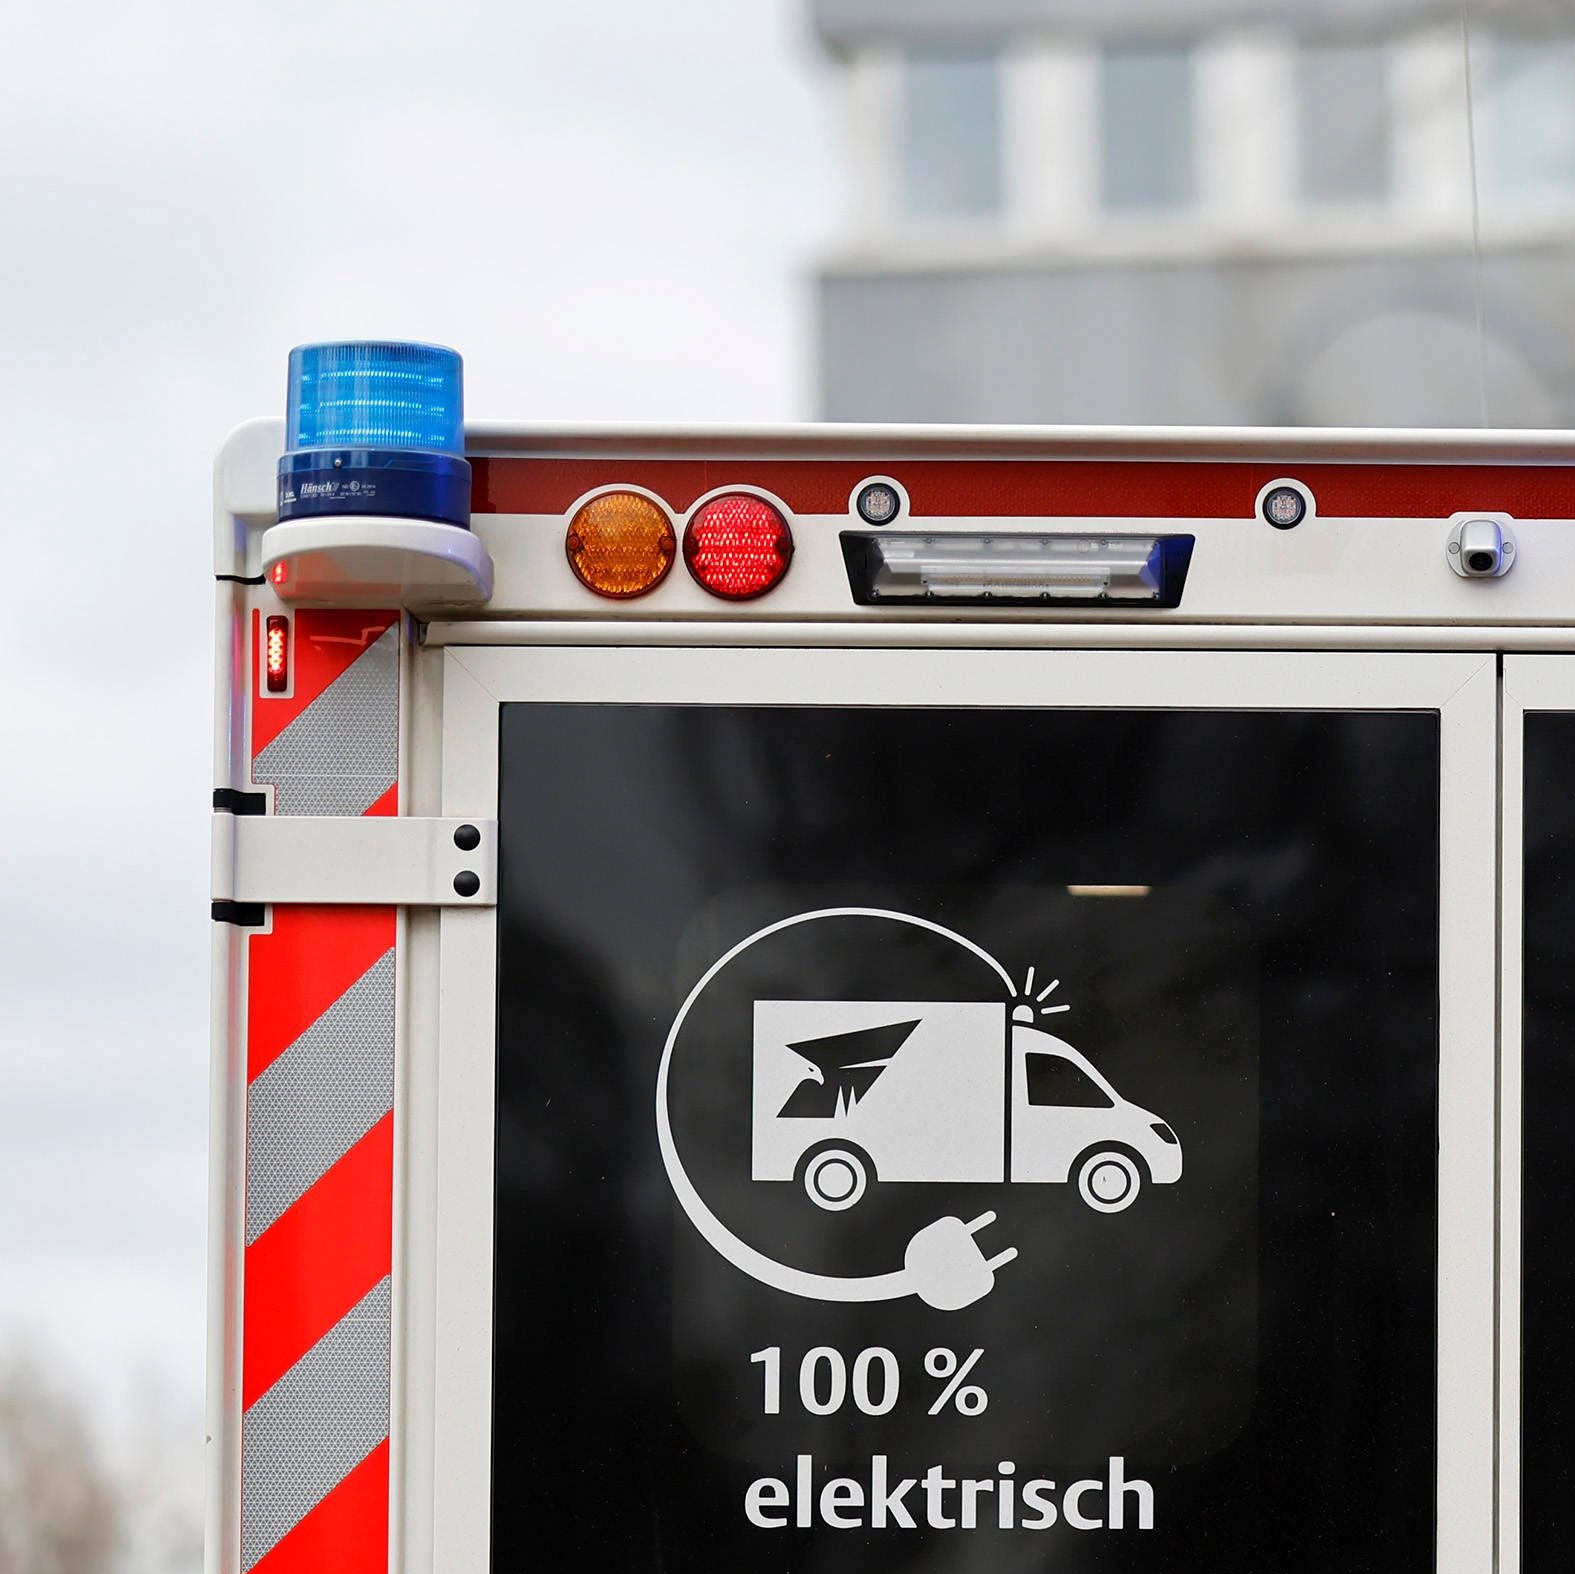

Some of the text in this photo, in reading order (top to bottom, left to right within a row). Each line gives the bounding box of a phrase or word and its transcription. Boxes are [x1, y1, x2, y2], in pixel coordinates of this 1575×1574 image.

[301, 482, 333, 495] Hänsch
[751, 1347, 988, 1416] 100 %
[745, 1455, 1153, 1529] elektrisch
